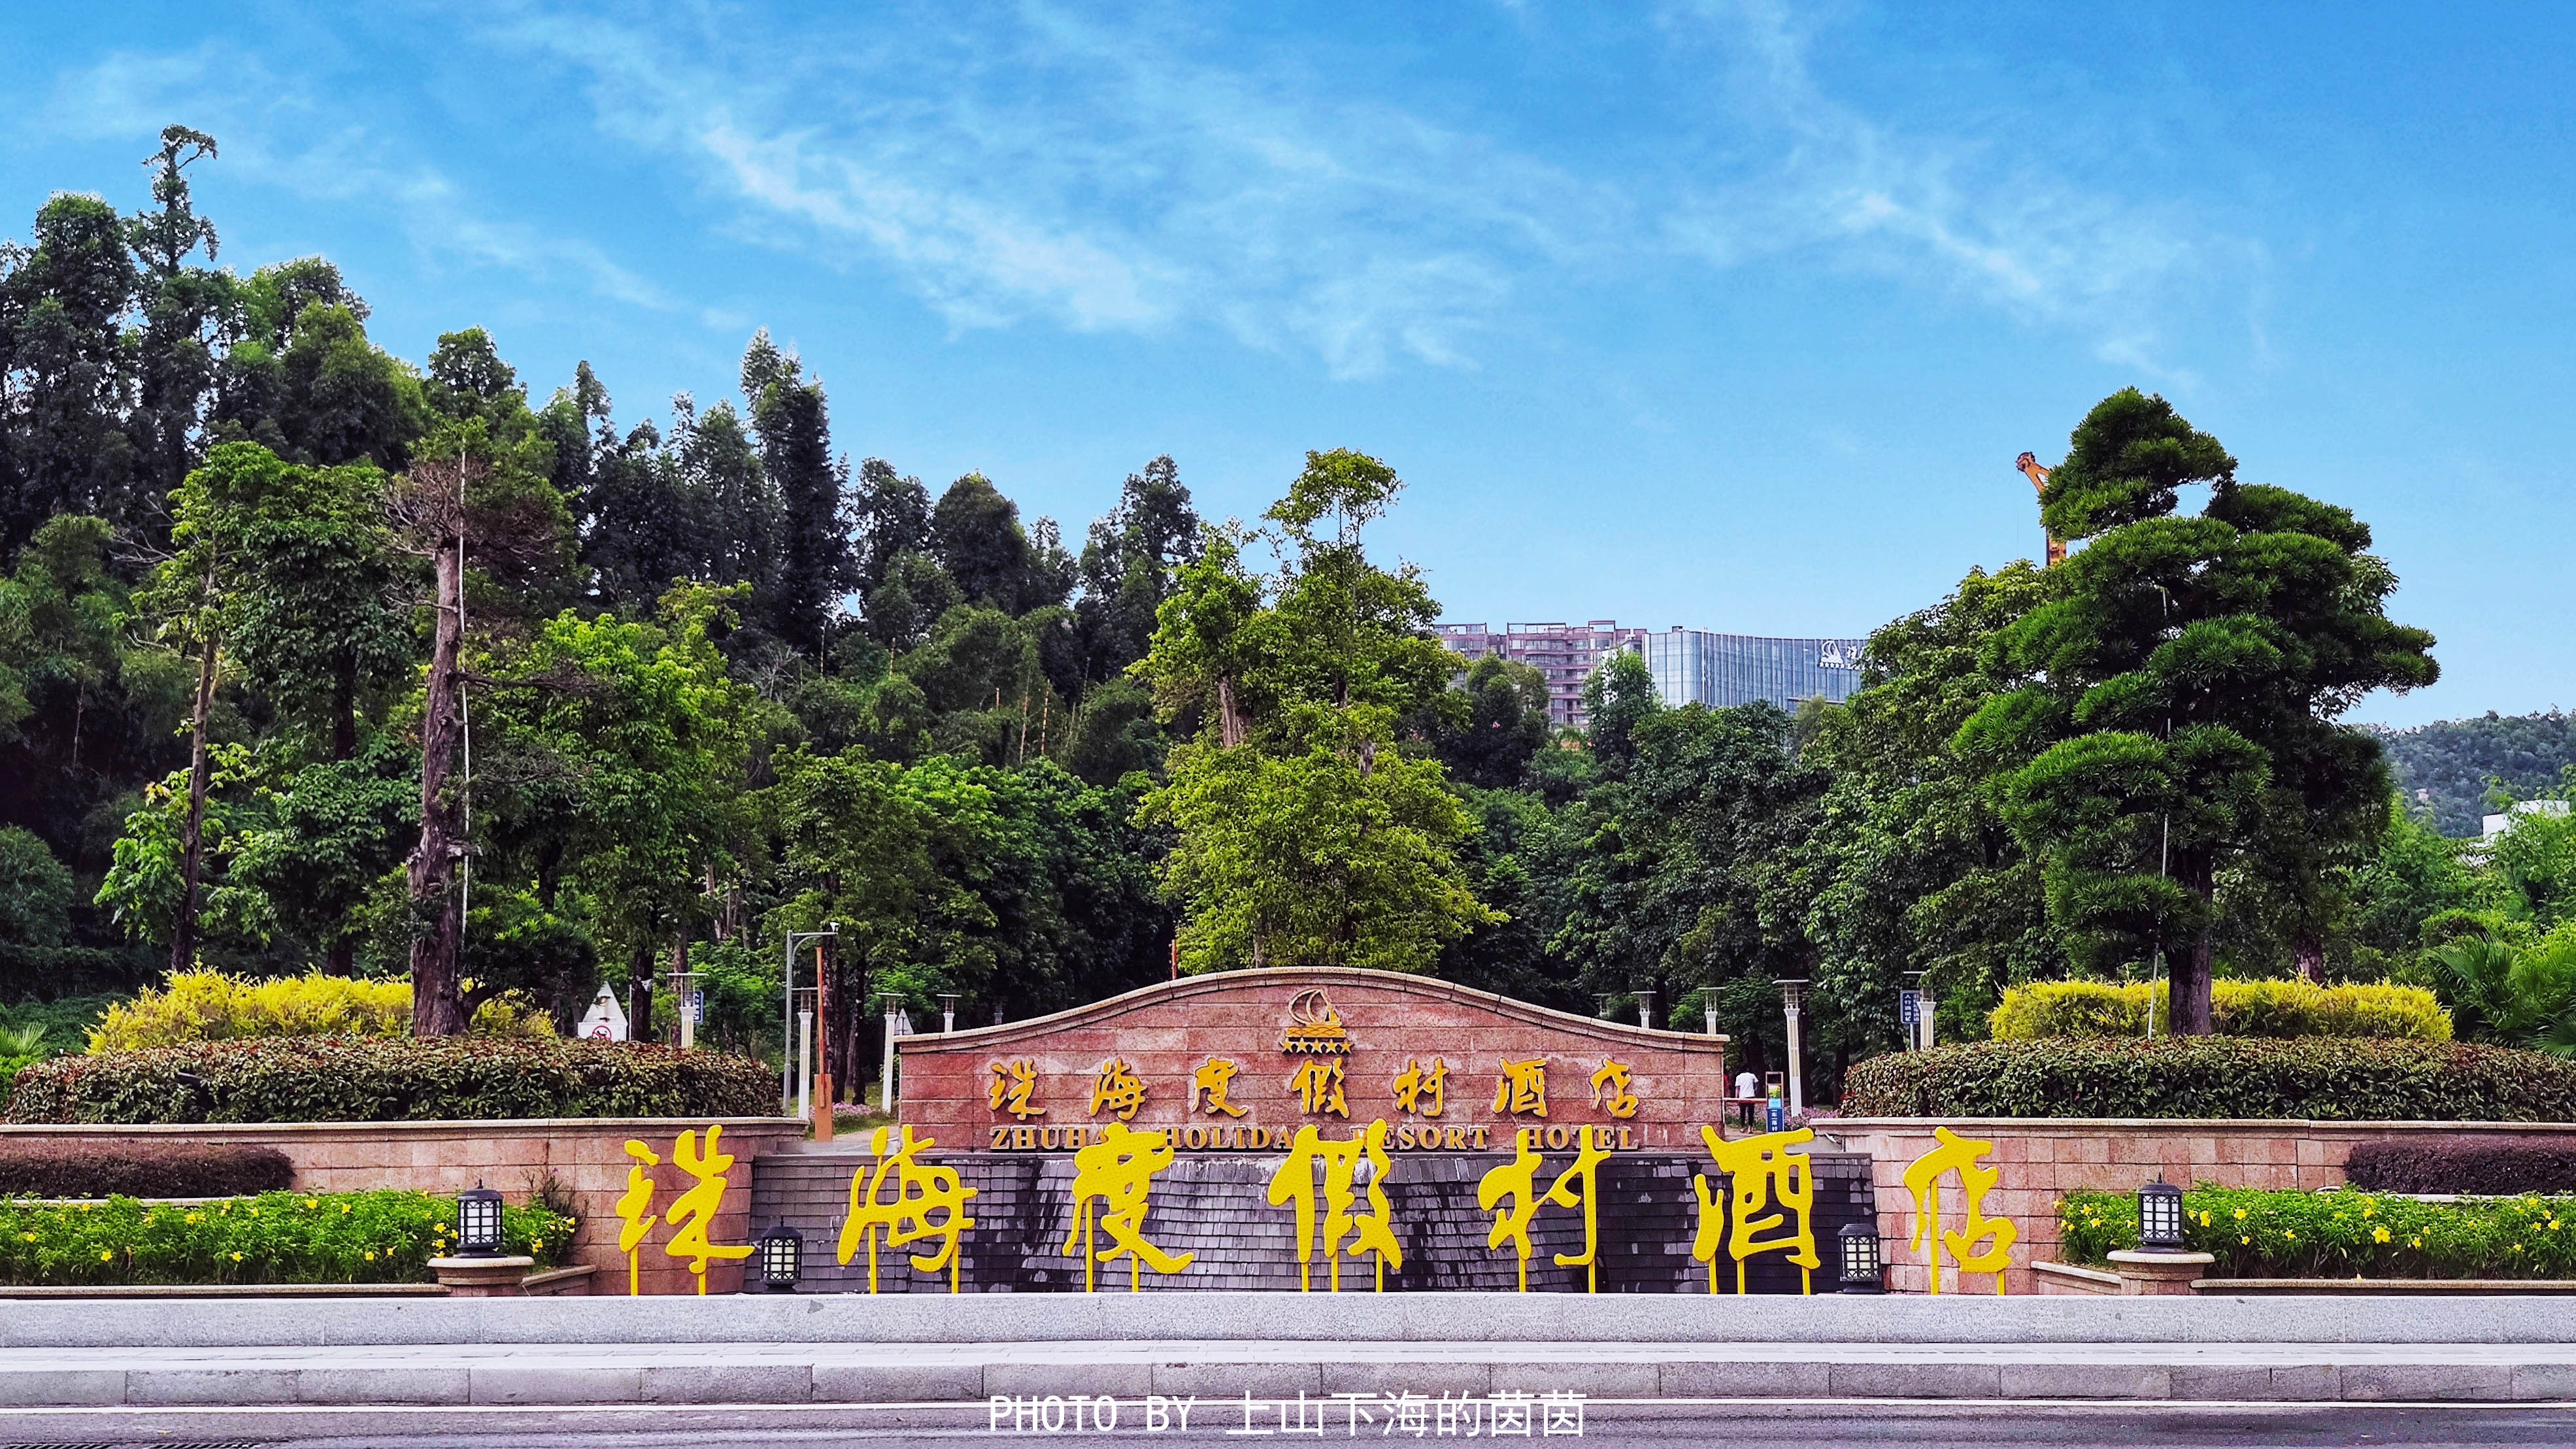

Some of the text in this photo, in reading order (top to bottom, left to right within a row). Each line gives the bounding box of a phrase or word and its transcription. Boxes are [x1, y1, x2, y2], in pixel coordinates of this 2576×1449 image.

[990, 1058, 1638, 1119] 珠海度假村酒店
[990, 1124, 1129, 1150] ZHUHA
[1156, 1124, 1320, 1150] HOLIDA
[617, 1122, 2016, 1273] 珠海度假村酒店
